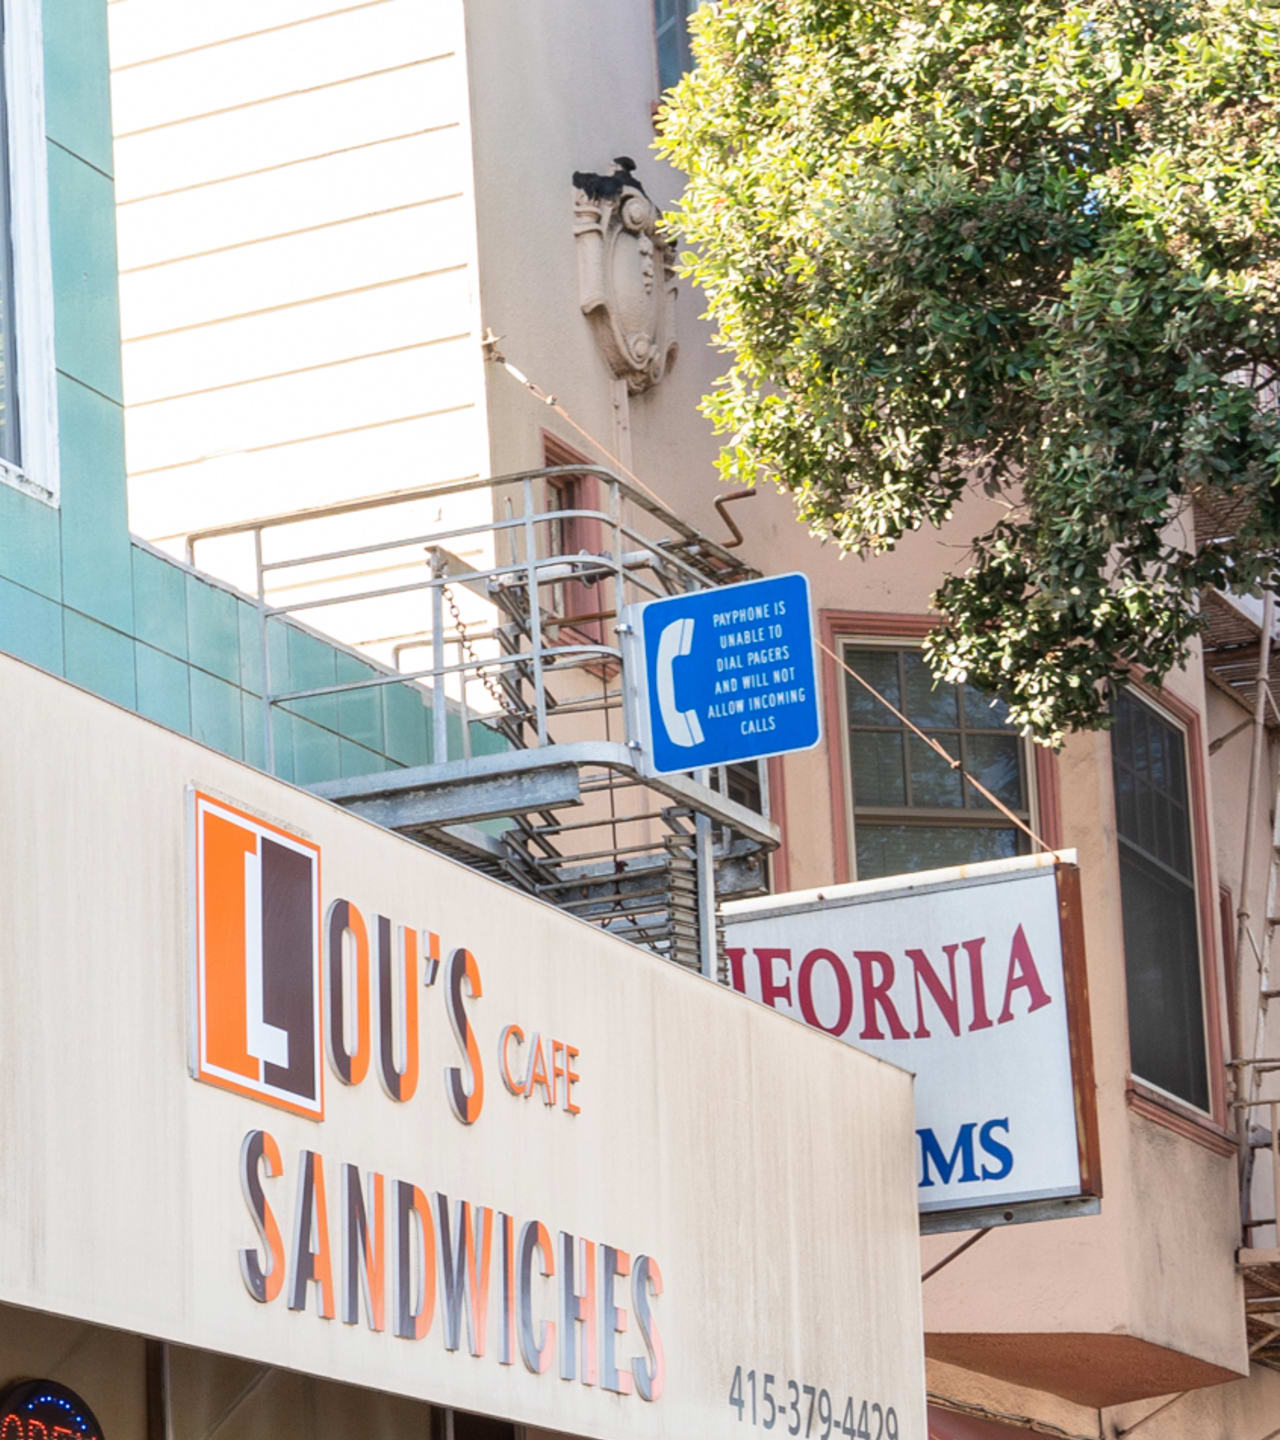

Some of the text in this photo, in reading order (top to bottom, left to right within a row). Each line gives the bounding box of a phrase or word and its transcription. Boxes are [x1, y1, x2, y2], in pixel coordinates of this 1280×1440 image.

[712, 601, 786, 628] PAYPHONE IS
[719, 624, 783, 649] UNABLE TO
[716, 646, 790, 672] DIAL PAGERS
[715, 666, 796, 695] AND WILL NOT
[707, 687, 806, 719] ALLOW INCOMING
[740, 716, 776, 736] CALLS
[240, 832, 582, 1125] LOU'S CAFE
[239, 1129, 666, 1401] SANDWICHES
